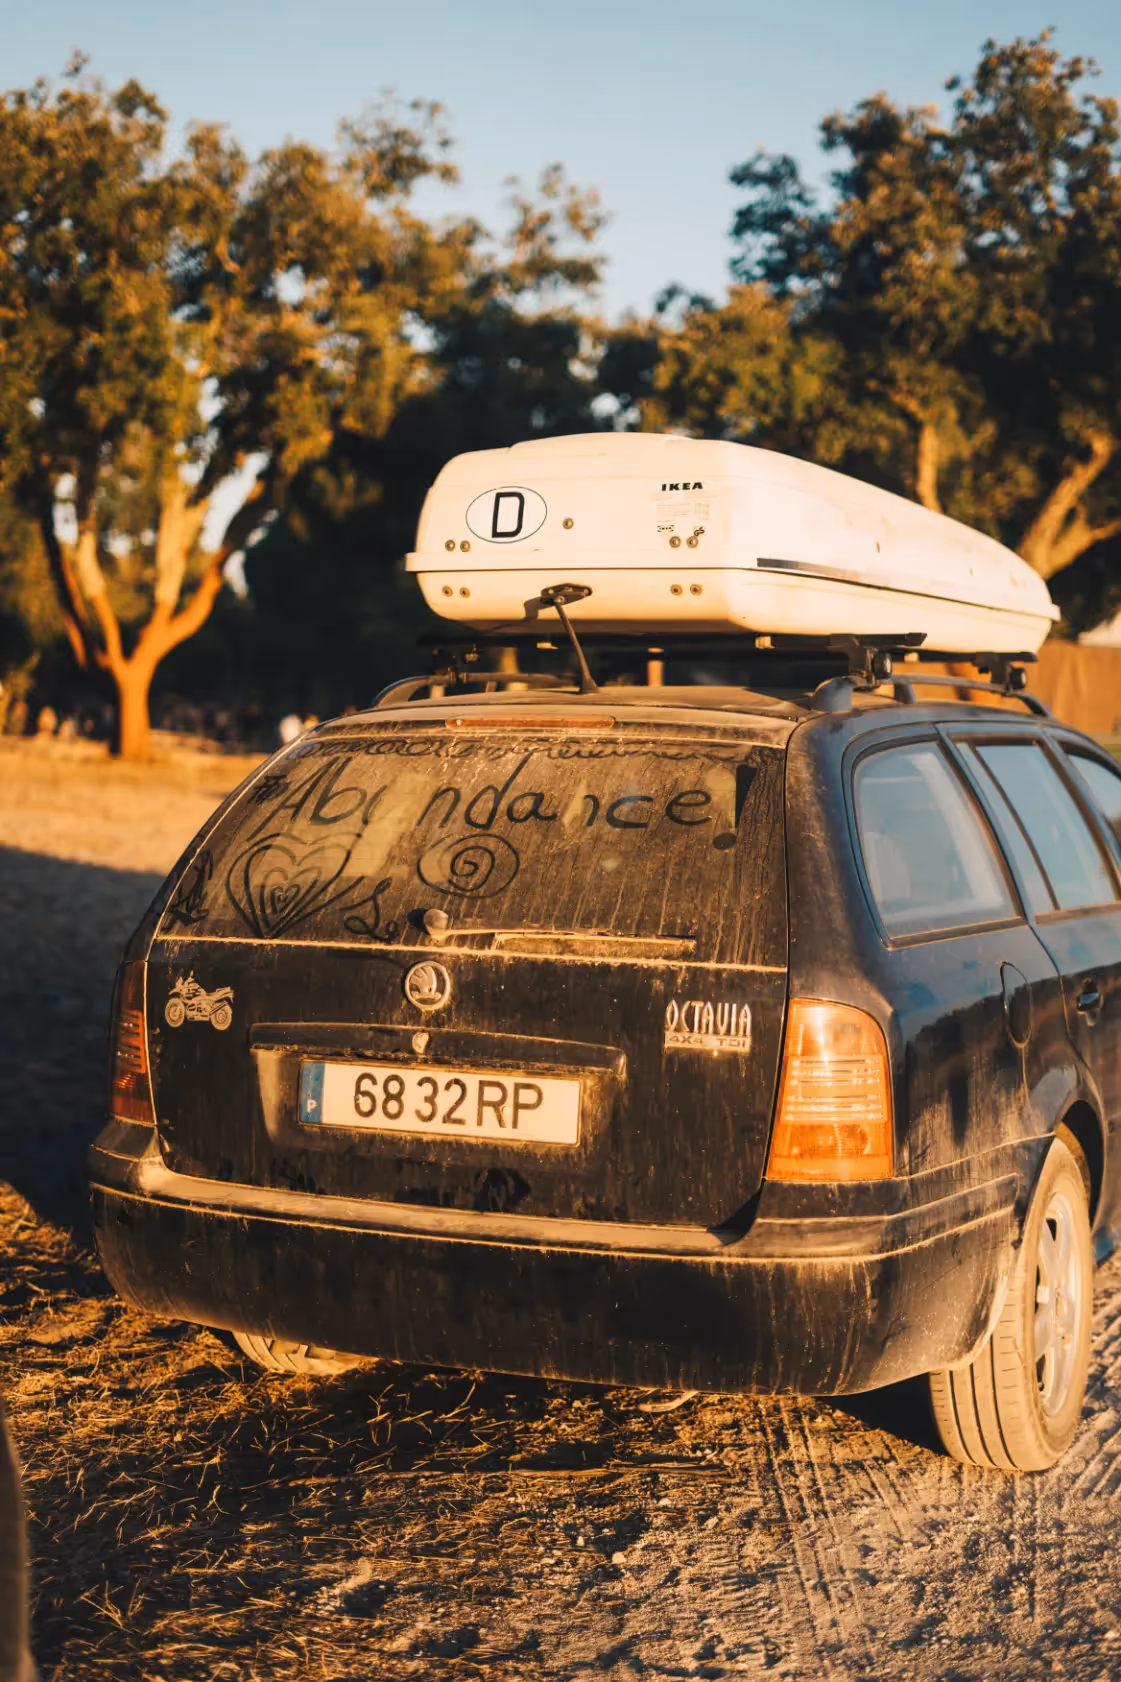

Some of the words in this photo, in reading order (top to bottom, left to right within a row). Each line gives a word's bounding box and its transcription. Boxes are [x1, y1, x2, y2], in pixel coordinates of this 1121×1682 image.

[661, 481, 703, 492] IKEA
[491, 491, 525, 538] D
[665, 1000, 752, 1036] OCTAVIA
